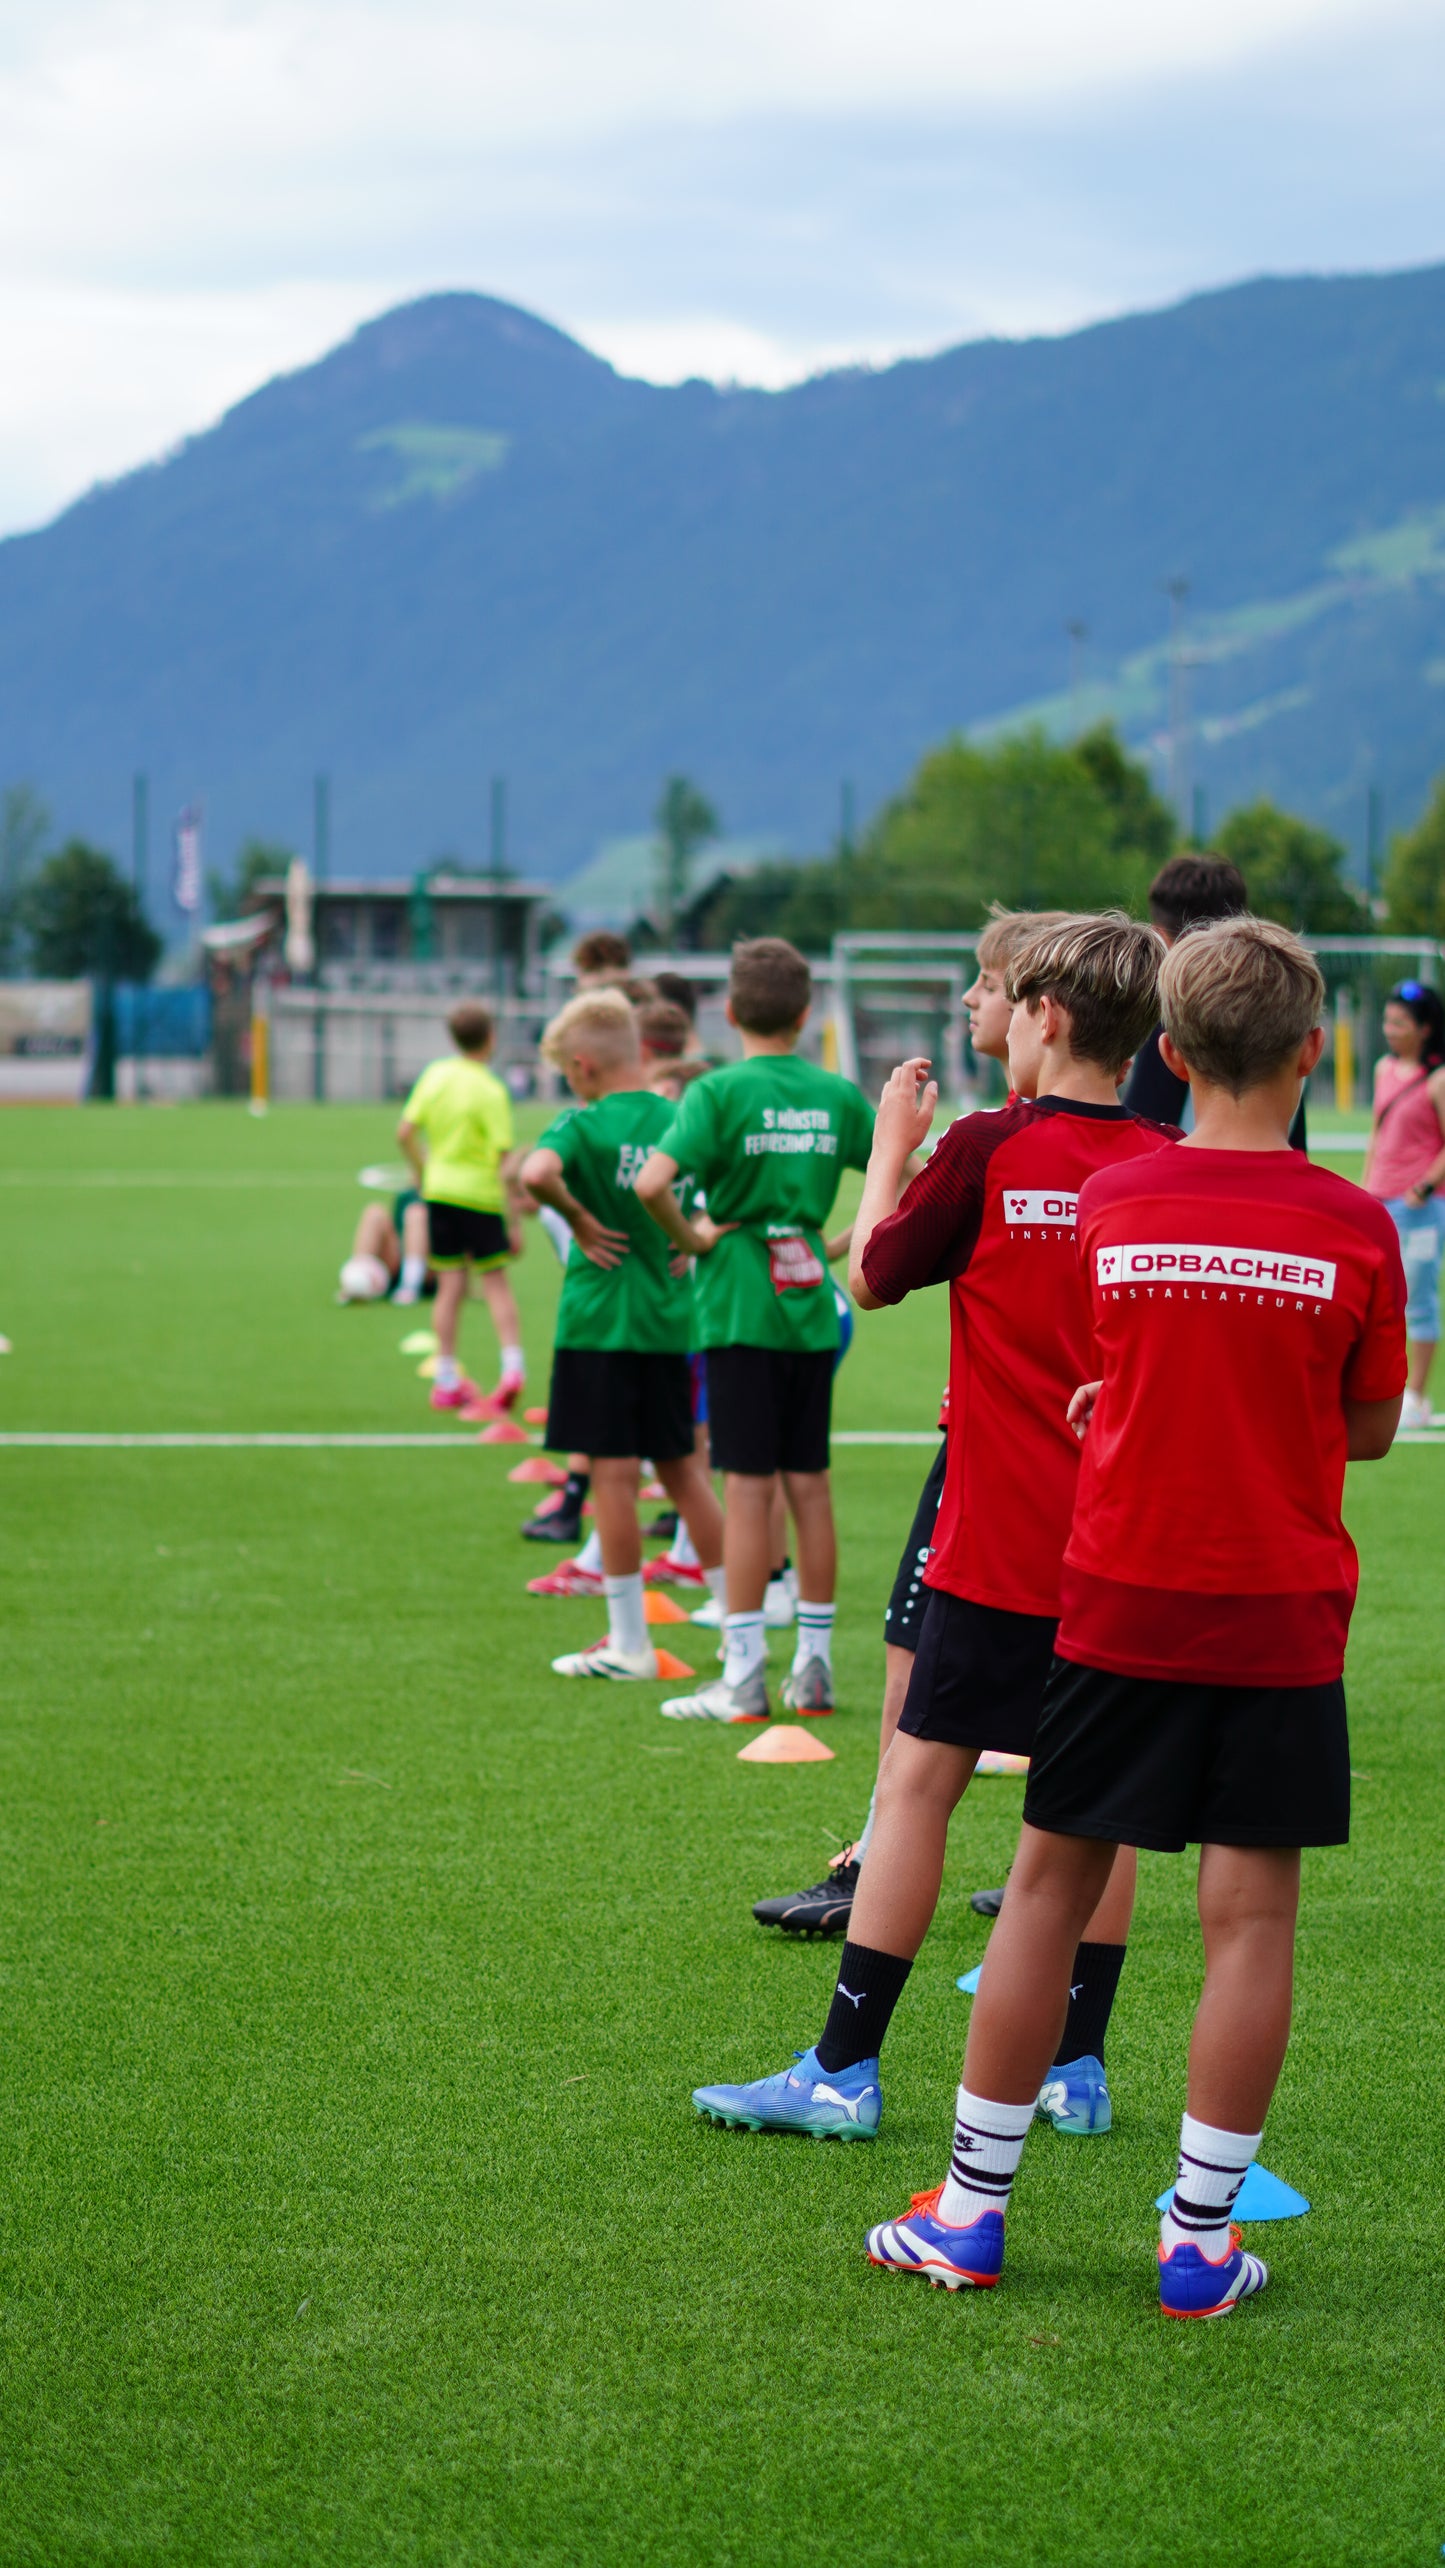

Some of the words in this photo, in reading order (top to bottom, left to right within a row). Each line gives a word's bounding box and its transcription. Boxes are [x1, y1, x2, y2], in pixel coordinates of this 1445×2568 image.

[1010, 1230, 1076, 1242] INSTA
[1130, 1254, 1325, 1289] OPBACHER
[1102, 1287, 1322, 1315] INSTALLATEURE
